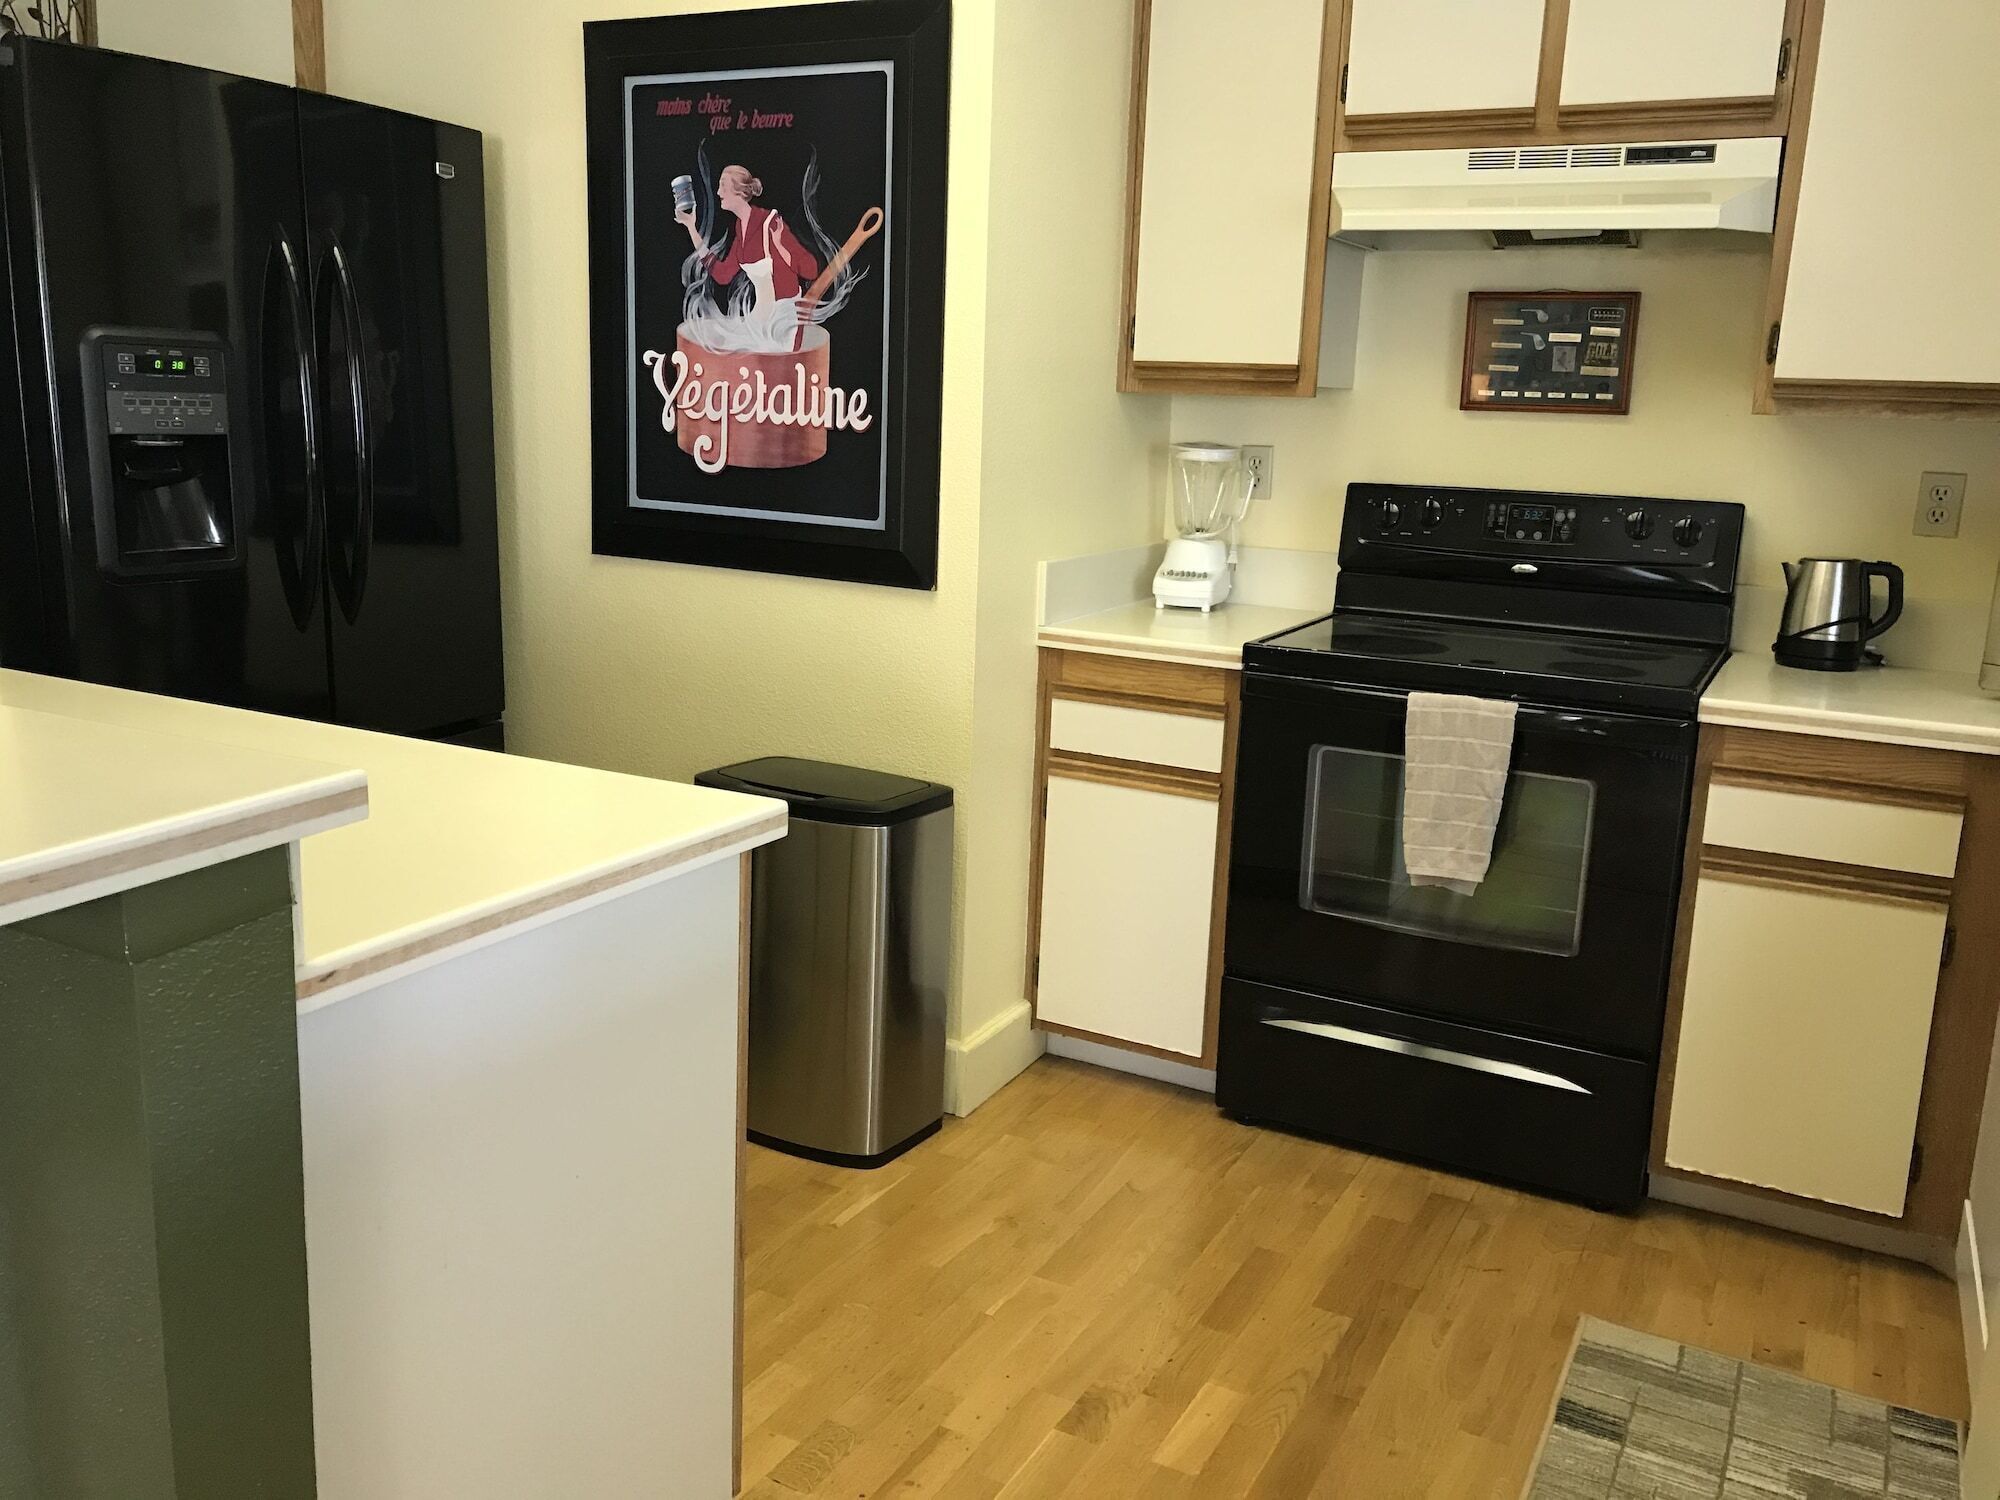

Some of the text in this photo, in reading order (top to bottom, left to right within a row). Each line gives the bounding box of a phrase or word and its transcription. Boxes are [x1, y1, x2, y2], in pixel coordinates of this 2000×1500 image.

[656, 96, 692, 116] moins
[709, 108, 794, 135] que le beurre
[172, 361, 184, 370] 38
[643, 350, 873, 474] Végétaline
